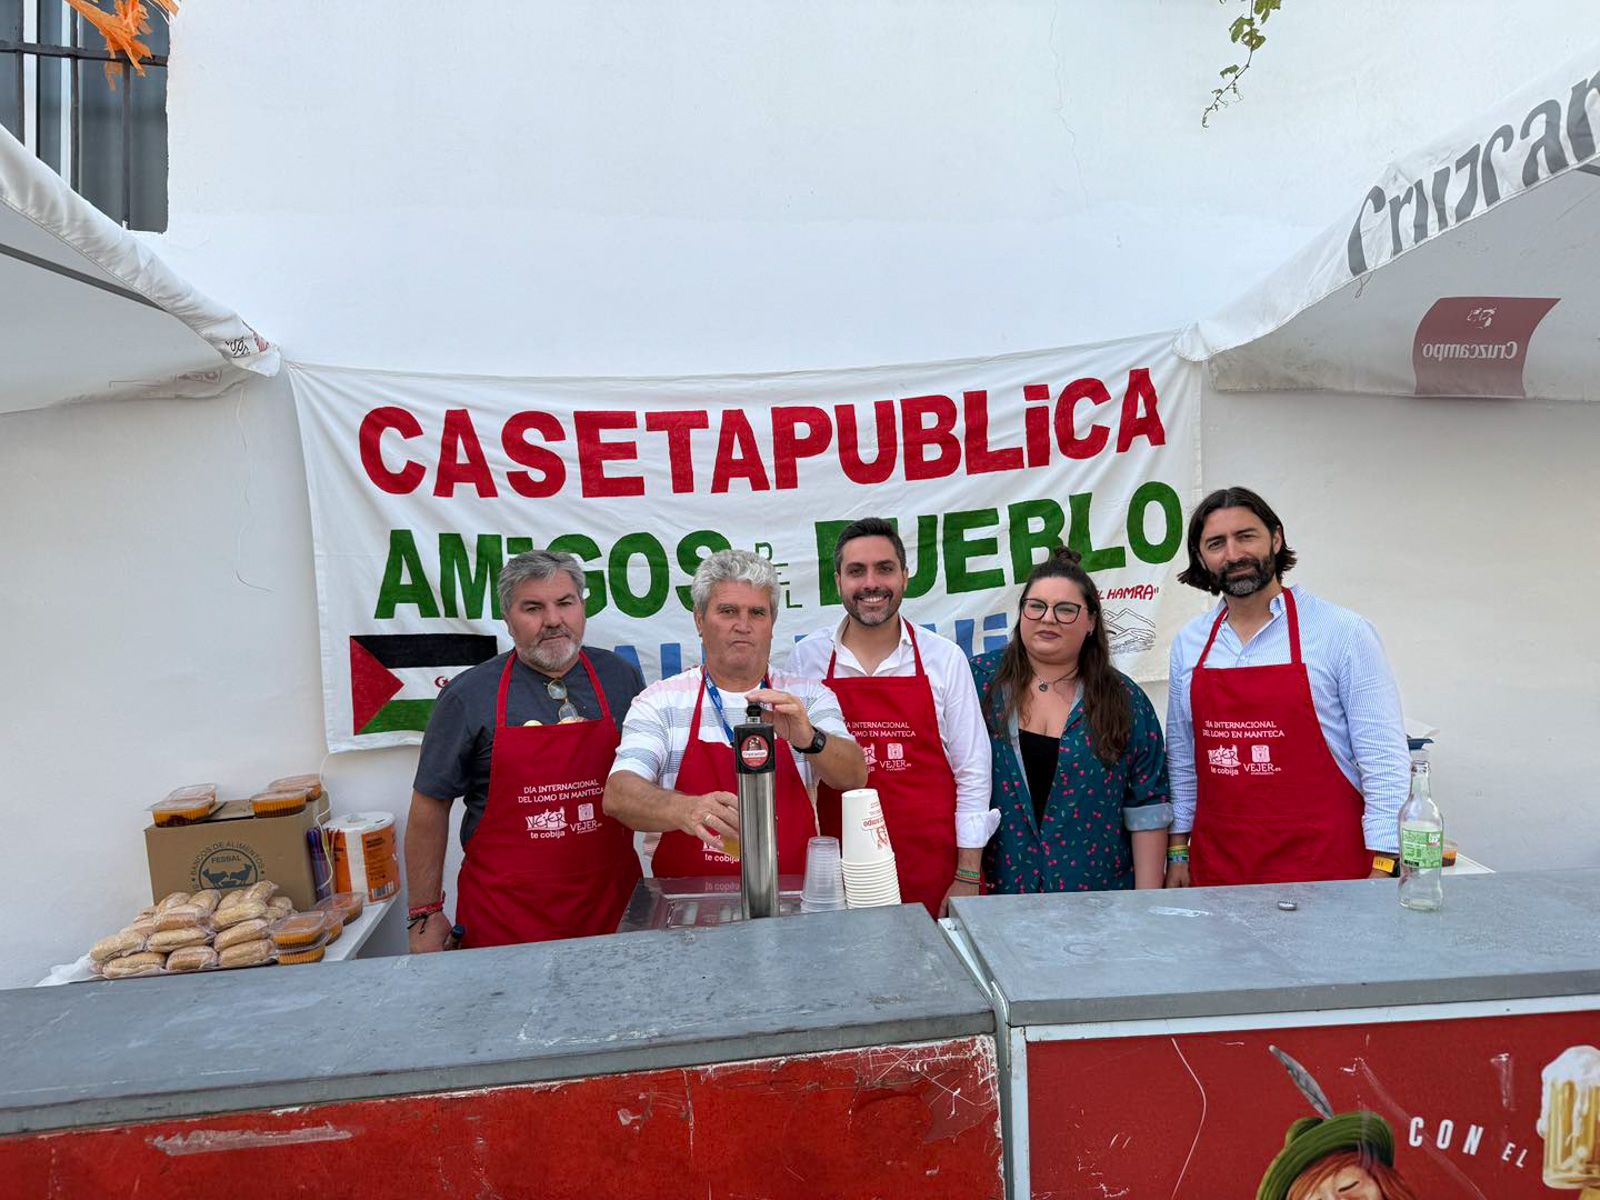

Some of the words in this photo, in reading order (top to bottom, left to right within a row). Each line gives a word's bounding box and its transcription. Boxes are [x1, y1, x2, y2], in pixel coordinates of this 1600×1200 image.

[1347, 70, 1600, 277] Cruzca
[1214, 721, 1277, 729] INTERNACIONAL
[1244, 730, 1285, 738] MANTECA
[538, 780, 599, 793] INTERNACIONAL
[533, 793, 558, 803] LOMO
[558, 791, 570, 800] EN
[570, 787, 605, 799] MANTECA
[539, 830, 566, 838] cobija
[1408, 1116, 1485, 1156] CON
[1501, 1142, 1528, 1169] EL
